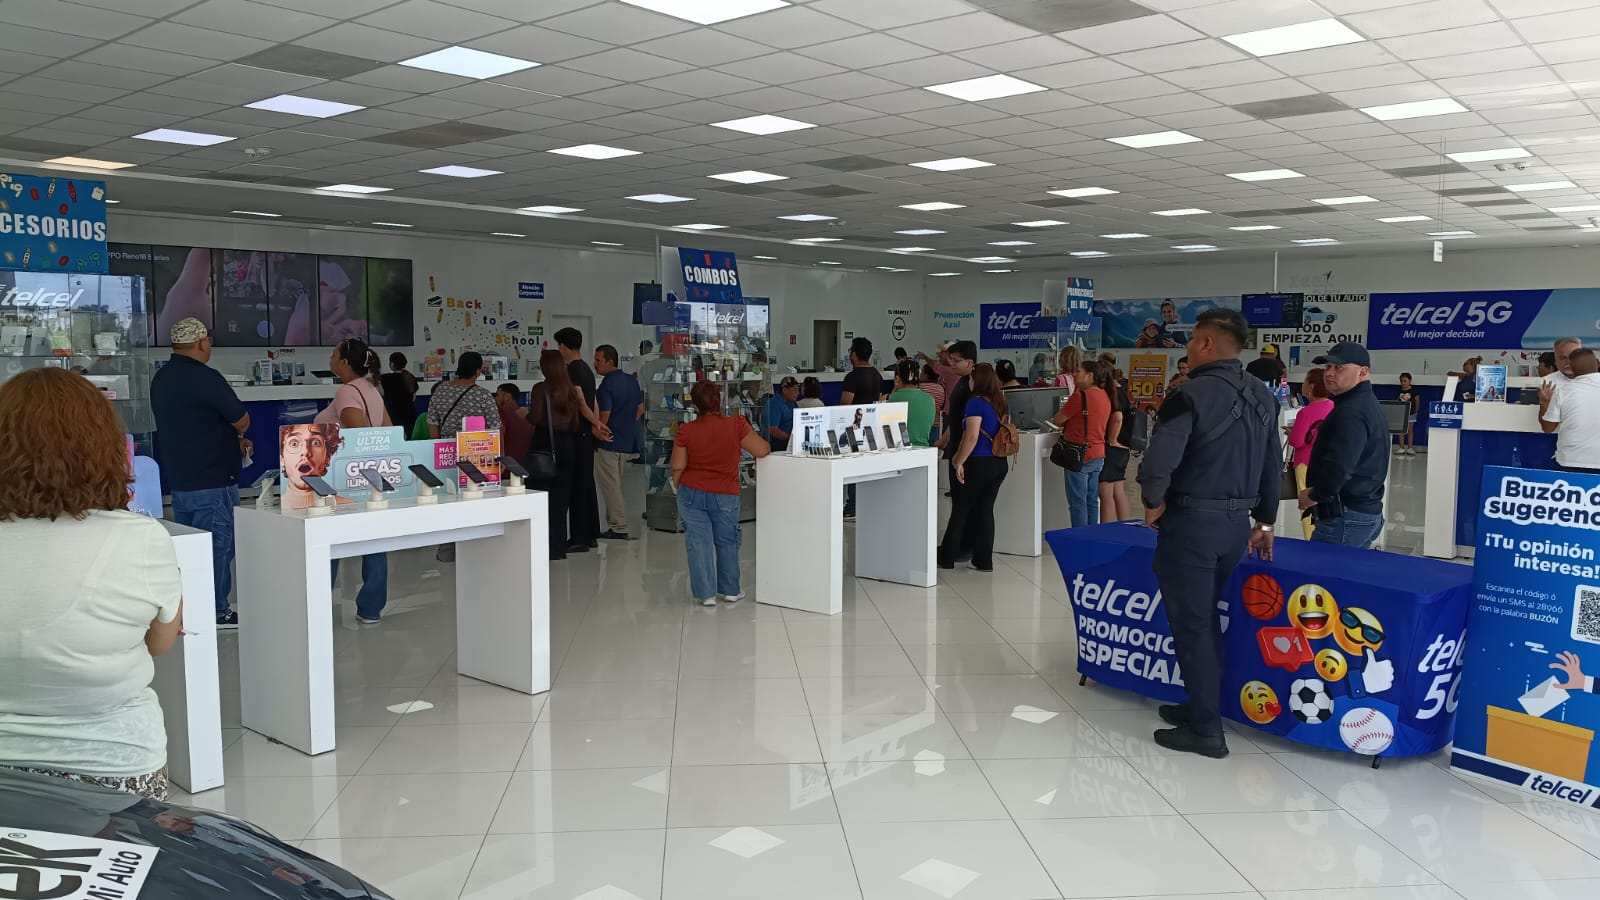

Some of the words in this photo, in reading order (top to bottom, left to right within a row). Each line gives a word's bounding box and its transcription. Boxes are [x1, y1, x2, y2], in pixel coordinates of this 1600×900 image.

[0, 212, 106, 242] CESORIOS
[684, 265, 738, 287] COMBOS
[1, 286, 85, 307] telcel
[447, 297, 481, 310] Back
[1343, 294, 1366, 302] AUTO
[483, 316, 496, 325] to
[714, 312, 744, 325] telcel
[934, 310, 975, 319] Promoción
[1380, 301, 1464, 325] telcel
[1464, 301, 1513, 327] 5G
[495, 333, 540, 345] School
[1012, 333, 1030, 342] mejor
[1263, 334, 1322, 344] EMPIEZA
[1403, 329, 1417, 338] Mi
[1418, 330, 1445, 340] mejor
[1446, 329, 1485, 338] decisión
[357, 436, 391, 446] ULTRA
[439, 445, 454, 454] MÁS
[1505, 480, 1581, 504] Buzón
[1489, 499, 1600, 526] sugerenc
[1485, 533, 1514, 550] ¡Tu
[1519, 540, 1595, 561] opinión
[1514, 553, 1600, 579] interesa!
[1073, 573, 1163, 622] telcel
[1485, 583, 1515, 595] Escanea
[1516, 587, 1523, 595] el
[1524, 589, 1549, 601] código
[1509, 597, 1526, 607] SMS
[1528, 600, 1534, 609] al
[1478, 604, 1492, 612] con
[1493, 605, 1500, 614] la
[1501, 608, 1528, 619] palabra
[1529, 613, 1559, 624] BUZÓN
[1530, 775, 1593, 804] telcel
[97, 850, 143, 886] Auto
